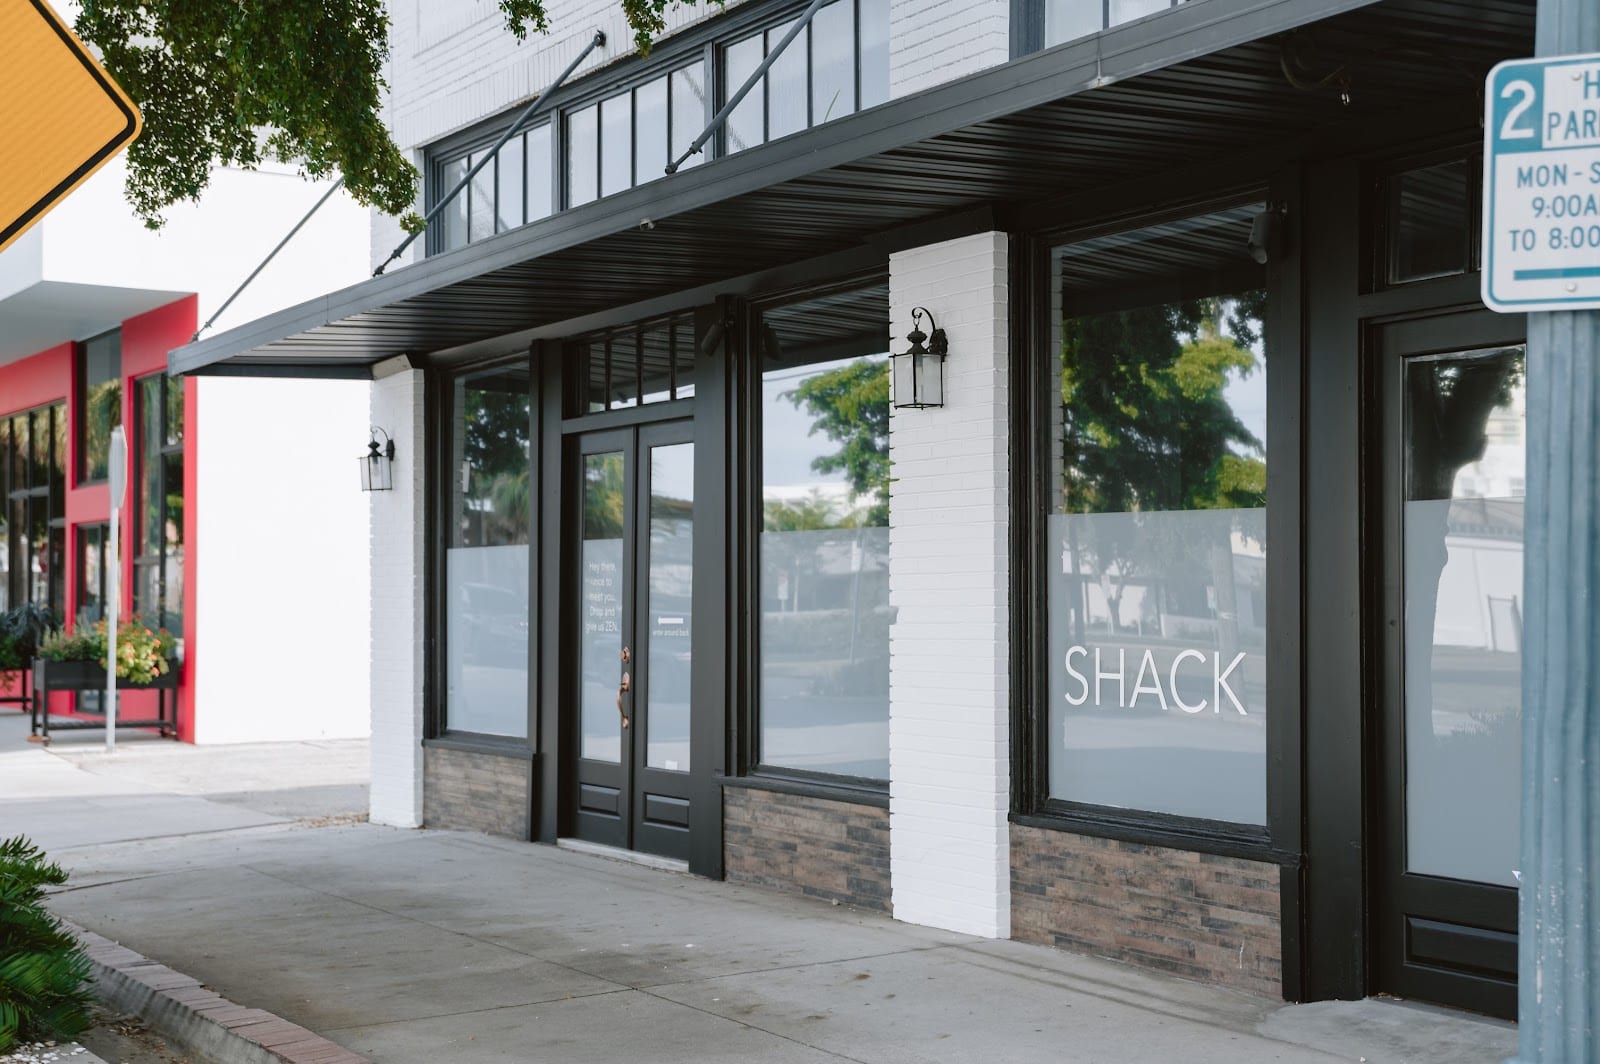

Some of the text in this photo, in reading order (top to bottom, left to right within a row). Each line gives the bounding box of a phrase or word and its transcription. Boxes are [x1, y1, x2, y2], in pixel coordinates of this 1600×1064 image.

[1499, 79, 1536, 140] 2
[1546, 110, 1600, 141] PAR
[1531, 194, 1600, 219] 9:00A
[1509, 229, 1536, 251] TO
[1064, 644, 1248, 716] SHACK
